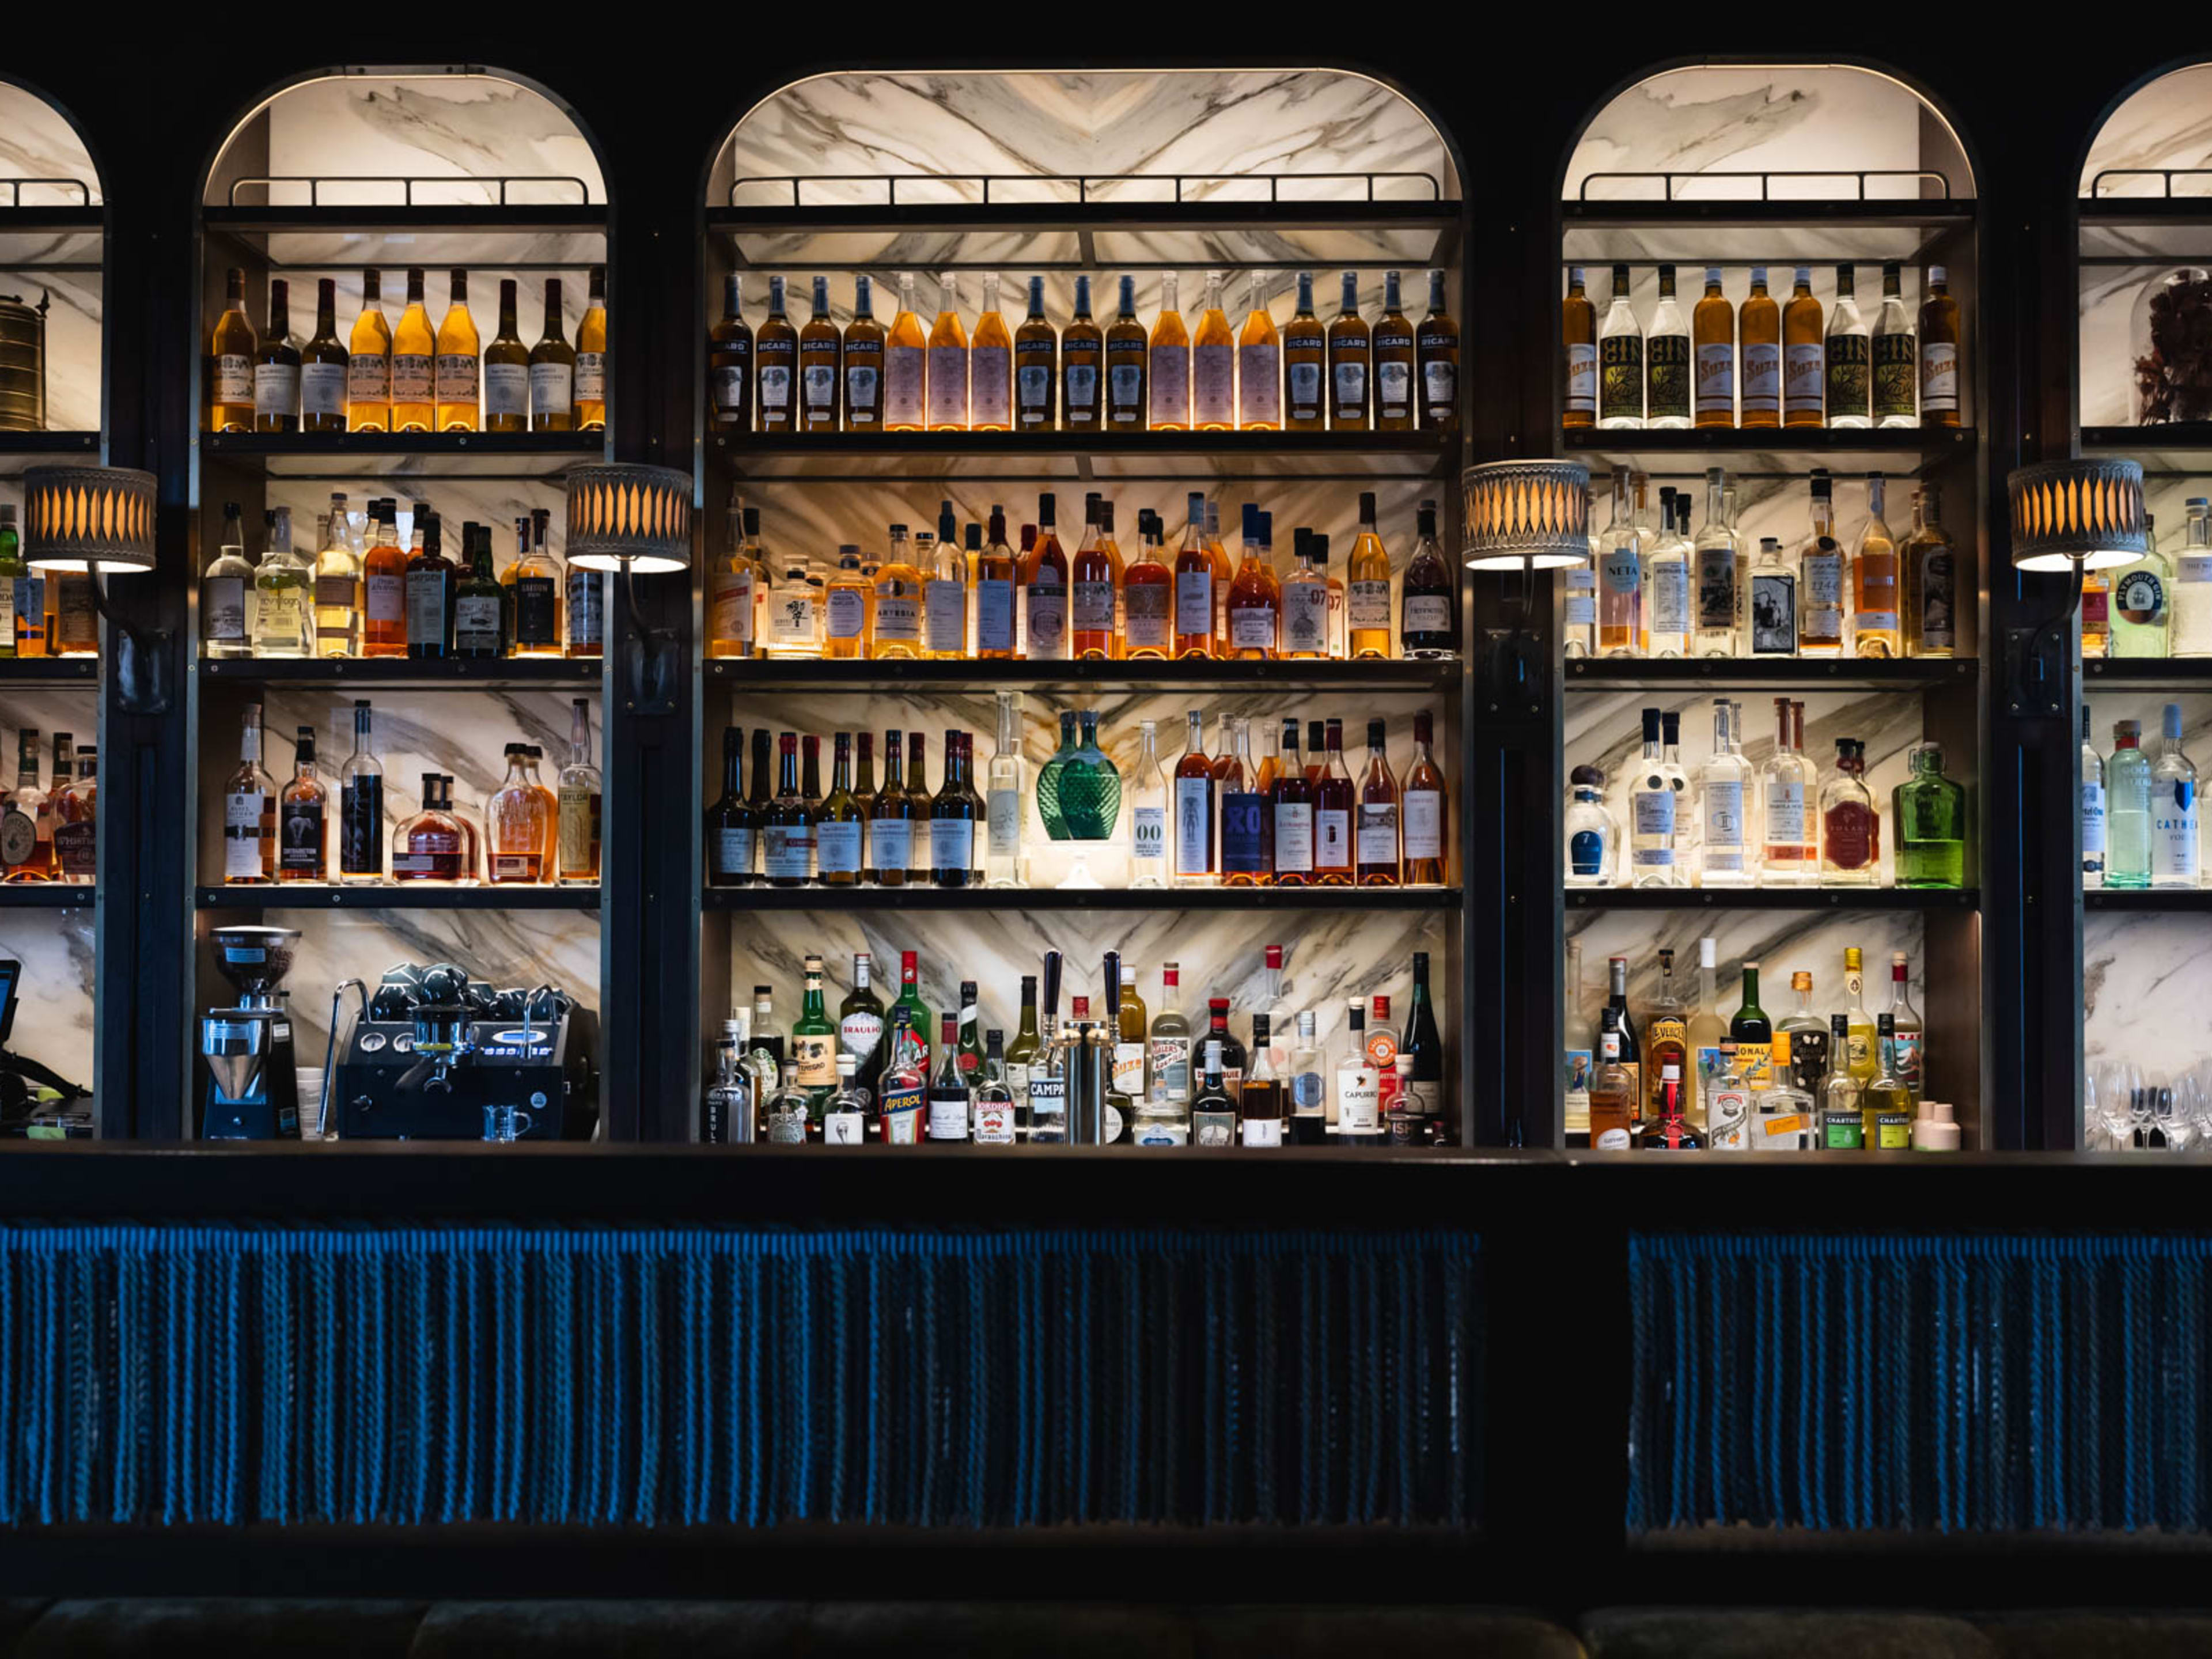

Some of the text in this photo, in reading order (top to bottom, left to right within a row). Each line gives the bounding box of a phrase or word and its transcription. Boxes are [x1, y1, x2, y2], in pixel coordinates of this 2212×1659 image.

[758, 341, 794, 351] RICARD
[802, 342, 837, 351] RICARD
[845, 342, 880, 351] RICARD
[1017, 342, 1052, 351] RICARD
[1064, 342, 1099, 351] RICARD
[1108, 342, 1143, 351] RICARD
[1287, 338, 1322, 349] RICARD
[1332, 338, 1367, 348] RICARD
[1376, 338, 1411, 347] RICARD
[1603, 336, 1643, 363] GIN
[1650, 337, 1689, 363] GIN
[1830, 336, 1867, 362] GIN
[1608, 566, 1638, 575] NETA
[2118, 574, 2162, 601] PLYMOUTH GIN
[1311, 589, 1326, 606] 07
[1227, 806, 1261, 834] XO
[2157, 819, 2198, 830] CATHE
[843, 1026, 881, 1034] BRAULIO
[1740, 1047, 1766, 1056] ONAL
[1030, 1083, 1065, 1096] CAMPA
[1344, 1090, 1378, 1099] CAPURRO
[884, 1094, 922, 1112] APEROL
